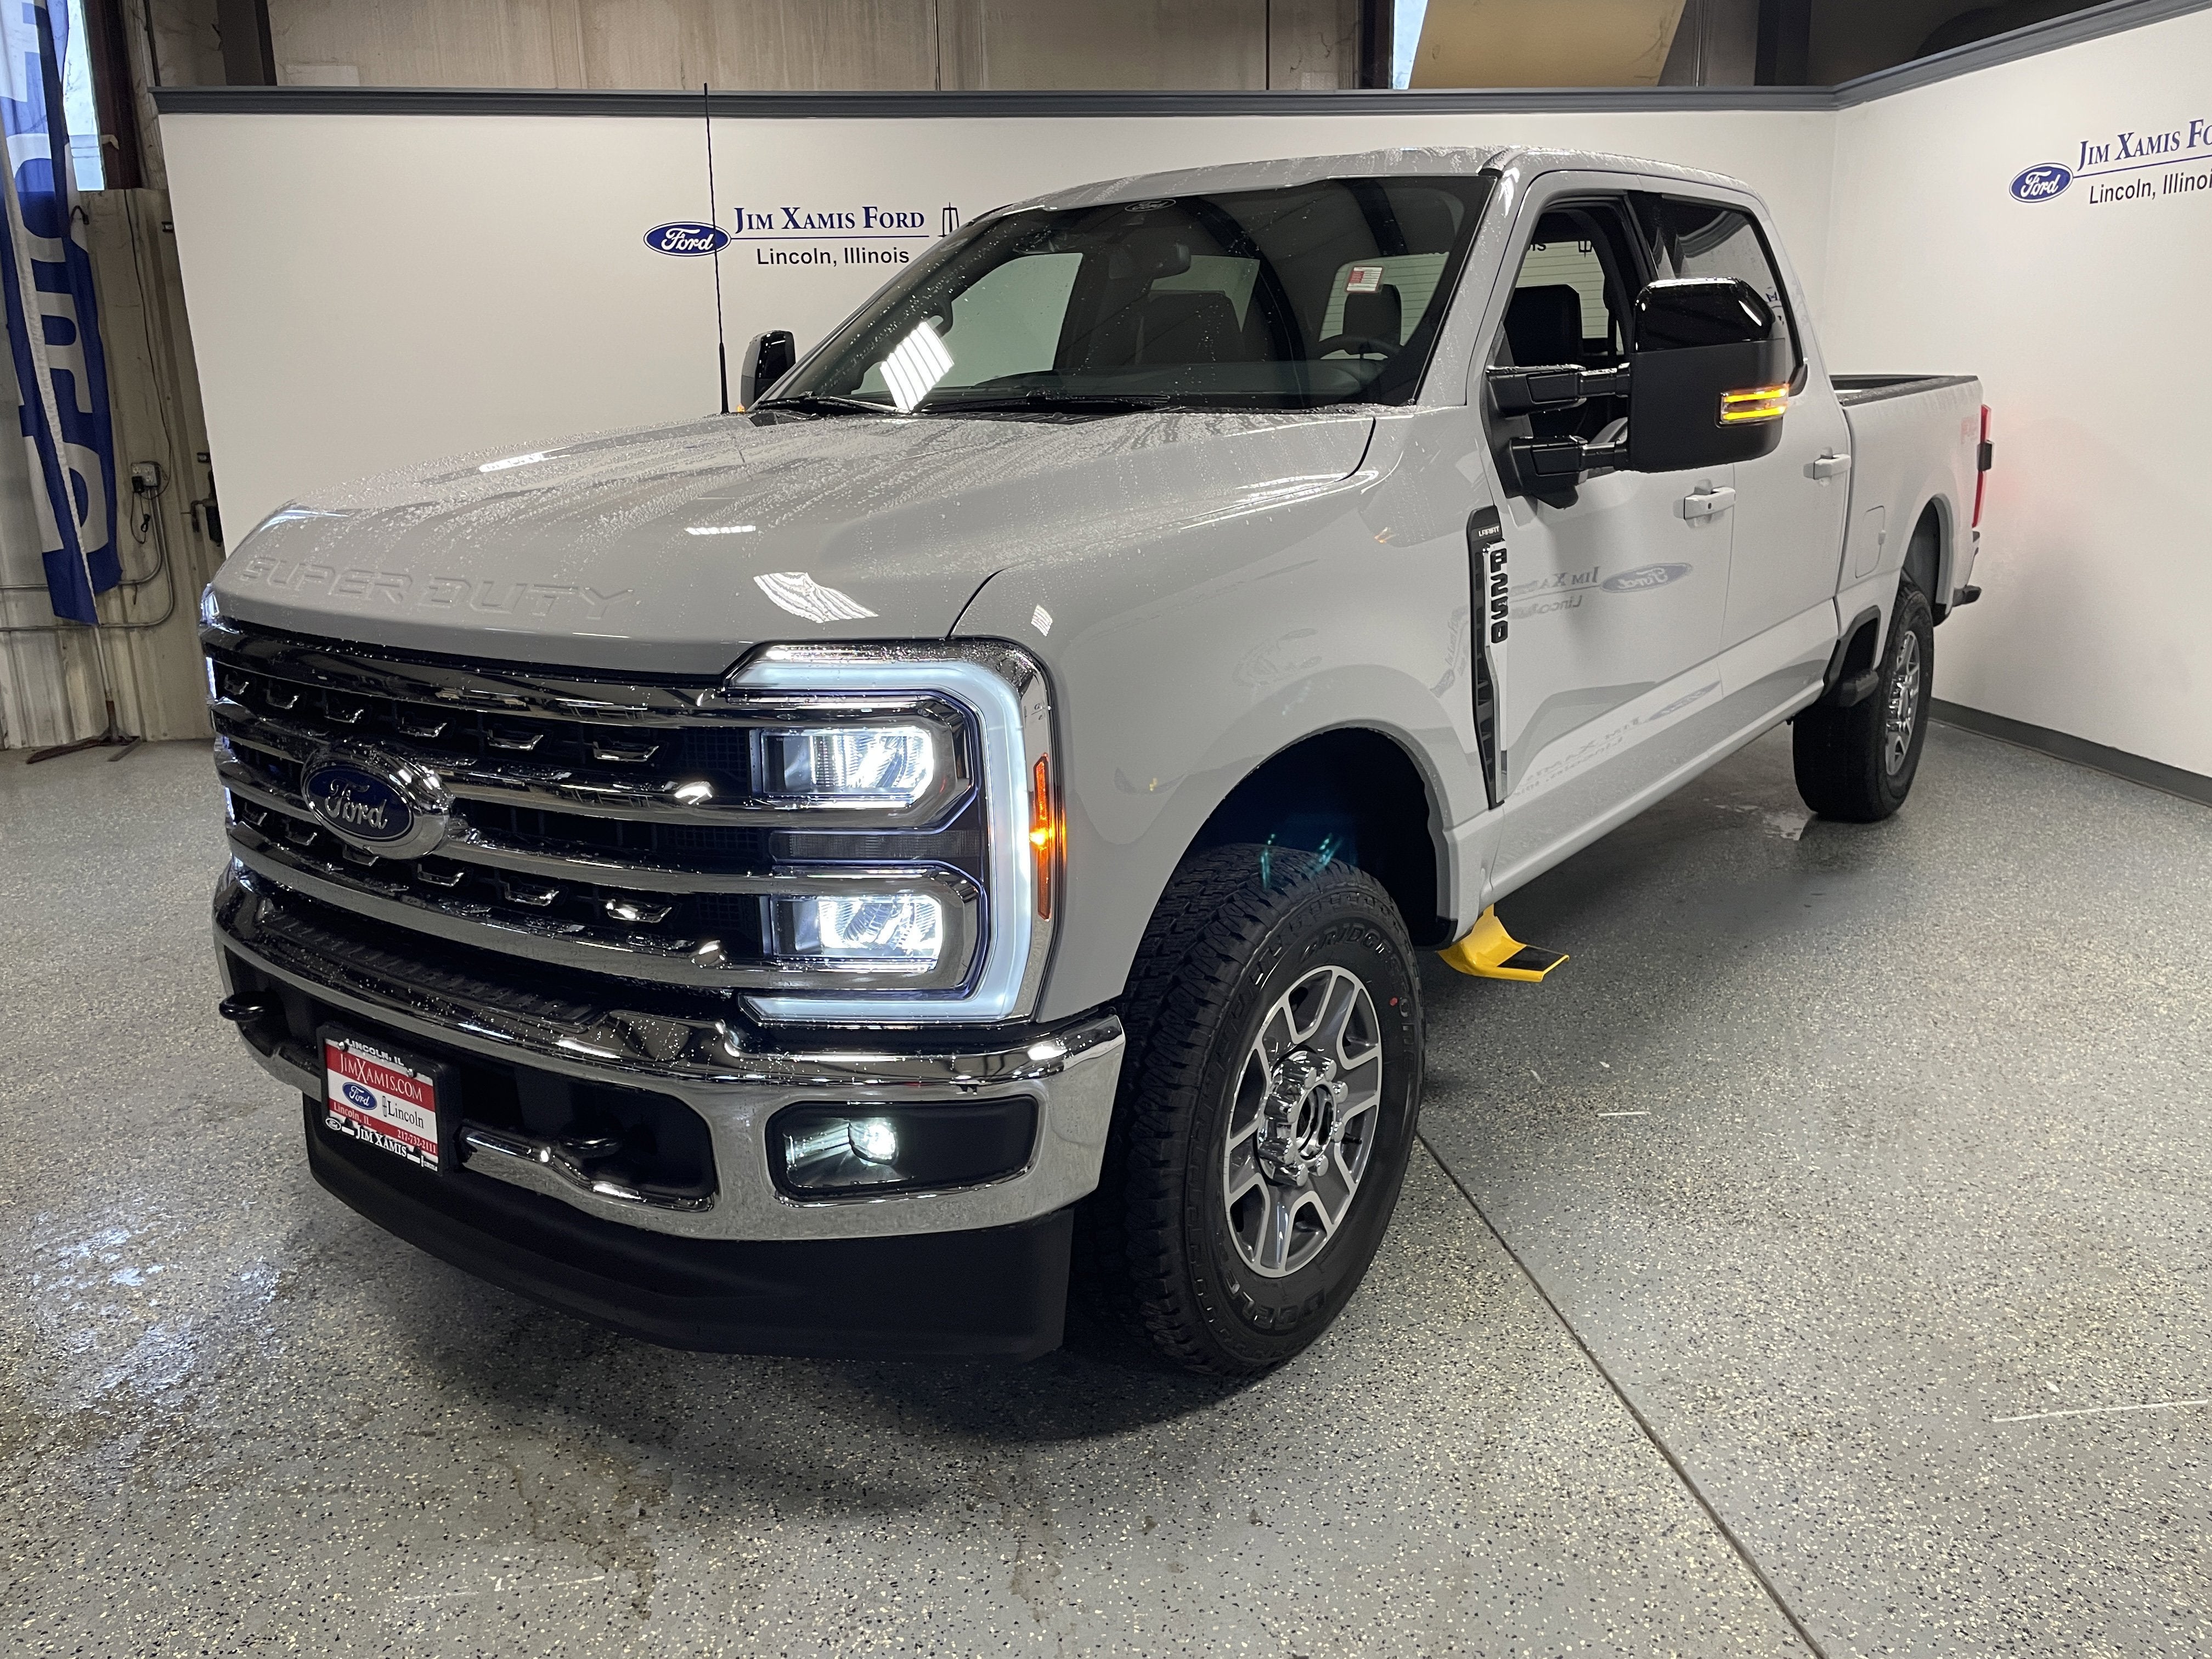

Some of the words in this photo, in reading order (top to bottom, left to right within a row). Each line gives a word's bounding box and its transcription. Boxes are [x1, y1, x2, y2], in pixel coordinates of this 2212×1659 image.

[2078, 140, 2111, 171] JIM
[2114, 131, 2180, 160] XAMIS
[2186, 119, 2212, 148] FO
[2021, 170, 2061, 198] Ford
[2090, 178, 2155, 204] Lincoln,
[2163, 168, 2212, 194] Illinoi
[734, 207, 774, 234] JIM
[780, 207, 855, 229] XAMIS
[862, 206, 924, 228] FORD
[661, 228, 714, 251] Ford
[757, 247, 837, 267] Lincoln,
[844, 247, 909, 263] Illinois
[238, 557, 413, 603] SUPER
[417, 577, 634, 619] DUTY
[325, 778, 387, 830] Ford
[346, 1039, 391, 1062] LINCOLN,
[394, 1056, 404, 1066] IL
[349, 1086, 370, 1107] Ford
[364, 1116, 372, 1126] IL
[387, 1101, 425, 1128] Lincoln
[356, 1126, 374, 1143] JIM
[375, 1132, 407, 1157] XAMIS
[398, 1130, 437, 1154] 217-732-2111
